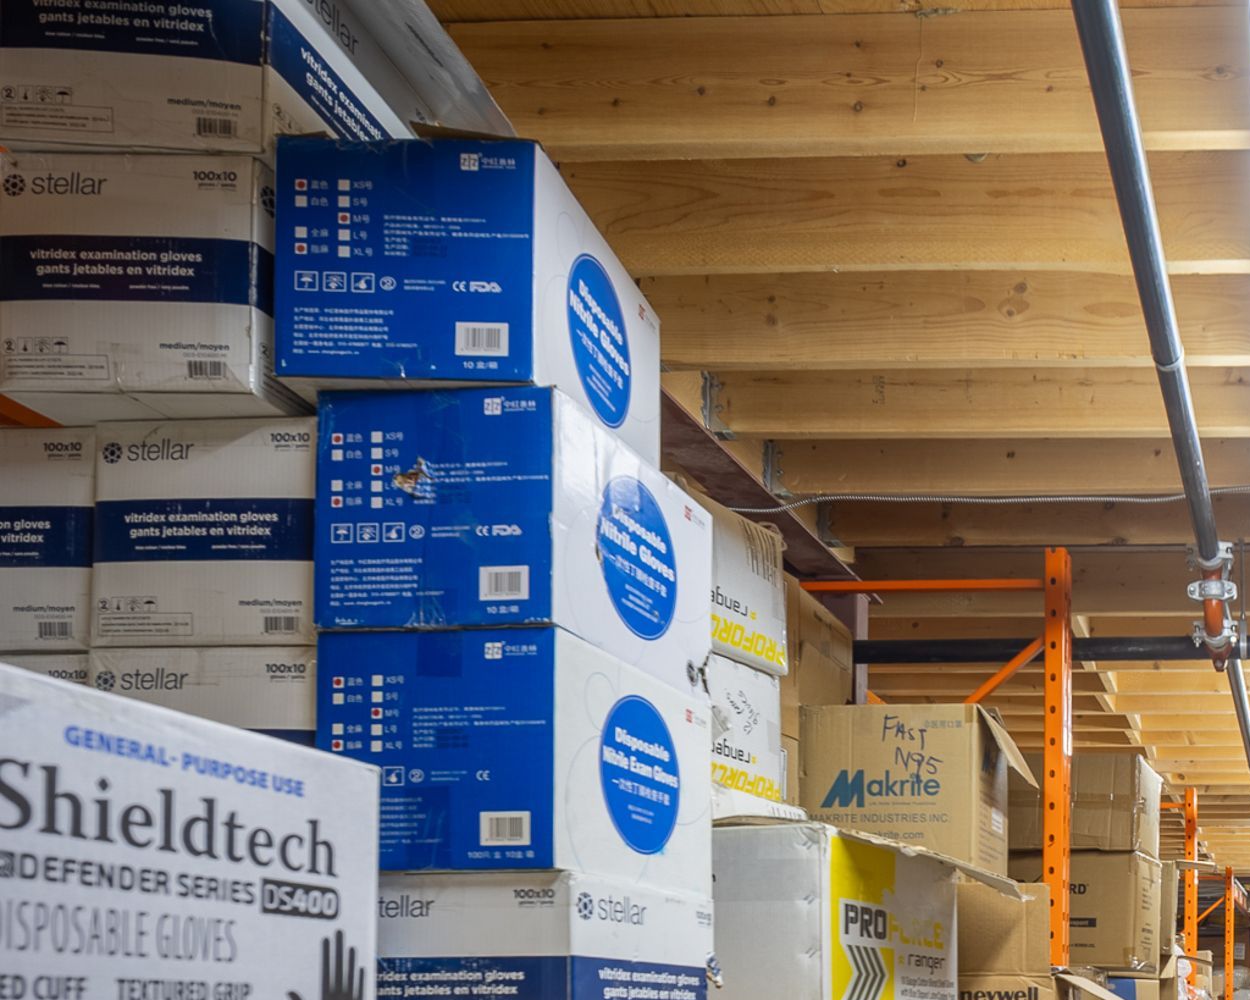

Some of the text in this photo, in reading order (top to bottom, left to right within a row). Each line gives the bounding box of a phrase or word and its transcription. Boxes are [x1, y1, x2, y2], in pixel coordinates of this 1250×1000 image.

[84, 0, 164, 15] examination
[169, 5, 212, 18] gloves
[39, 12, 205, 32] gants jetables en vitridex
[307, 0, 359, 55] tellar
[301, 48, 338, 94] vitridex
[306, 72, 332, 106] gants
[31, 170, 237, 195] stellar 100x10
[30, 249, 202, 263] vitridex examination gloves
[36, 264, 194, 277] gants jetables en vitridex
[470, 282, 502, 293] FDA
[160, 342, 229, 353] medium/moyen
[43, 442, 82, 452] 100x10
[127, 432, 310, 461] stellar 100x10
[13, 519, 51, 531] gloves
[124, 511, 278, 524] vitridex examination gloves
[1, 533, 44, 543] vitridex
[130, 525, 271, 538] gants jetables en vitridex
[492, 525, 522, 536] FDA
[239, 599, 302, 608] medium/moyen
[121, 663, 305, 691] stellar 100x10
[615, 727, 670, 762] Disposable
[603, 745, 679, 788] Nitrile Exam Gloves
[895, 747, 943, 775] N95
[272, 775, 305, 797] USE
[821, 769, 941, 808] Makrite
[0, 758, 339, 878] Shieldtech
[810, 813, 858, 823] MAKRITE
[860, 813, 926, 824] INDUSTRIES
[19, 853, 338, 916] DEFENDER SERIES DS400
[513, 888, 555, 899] 100x10
[598, 896, 647, 925] stellar
[0, 900, 238, 963] ISPOSABLE GLOVES
[844, 903, 945, 950] PROFE
[908, 953, 946, 975] ranger
[410, 969, 481, 982] examination
[485, 969, 524, 982] gloves
[599, 968, 699, 987] vitridex examination gloves
[32, 976, 88, 1000] CUFF
[404, 985, 451, 996] jetables
[454, 987, 469, 995] en
[472, 984, 518, 995] vitridex
[604, 986, 696, 1000] gants jetables en vitridex
